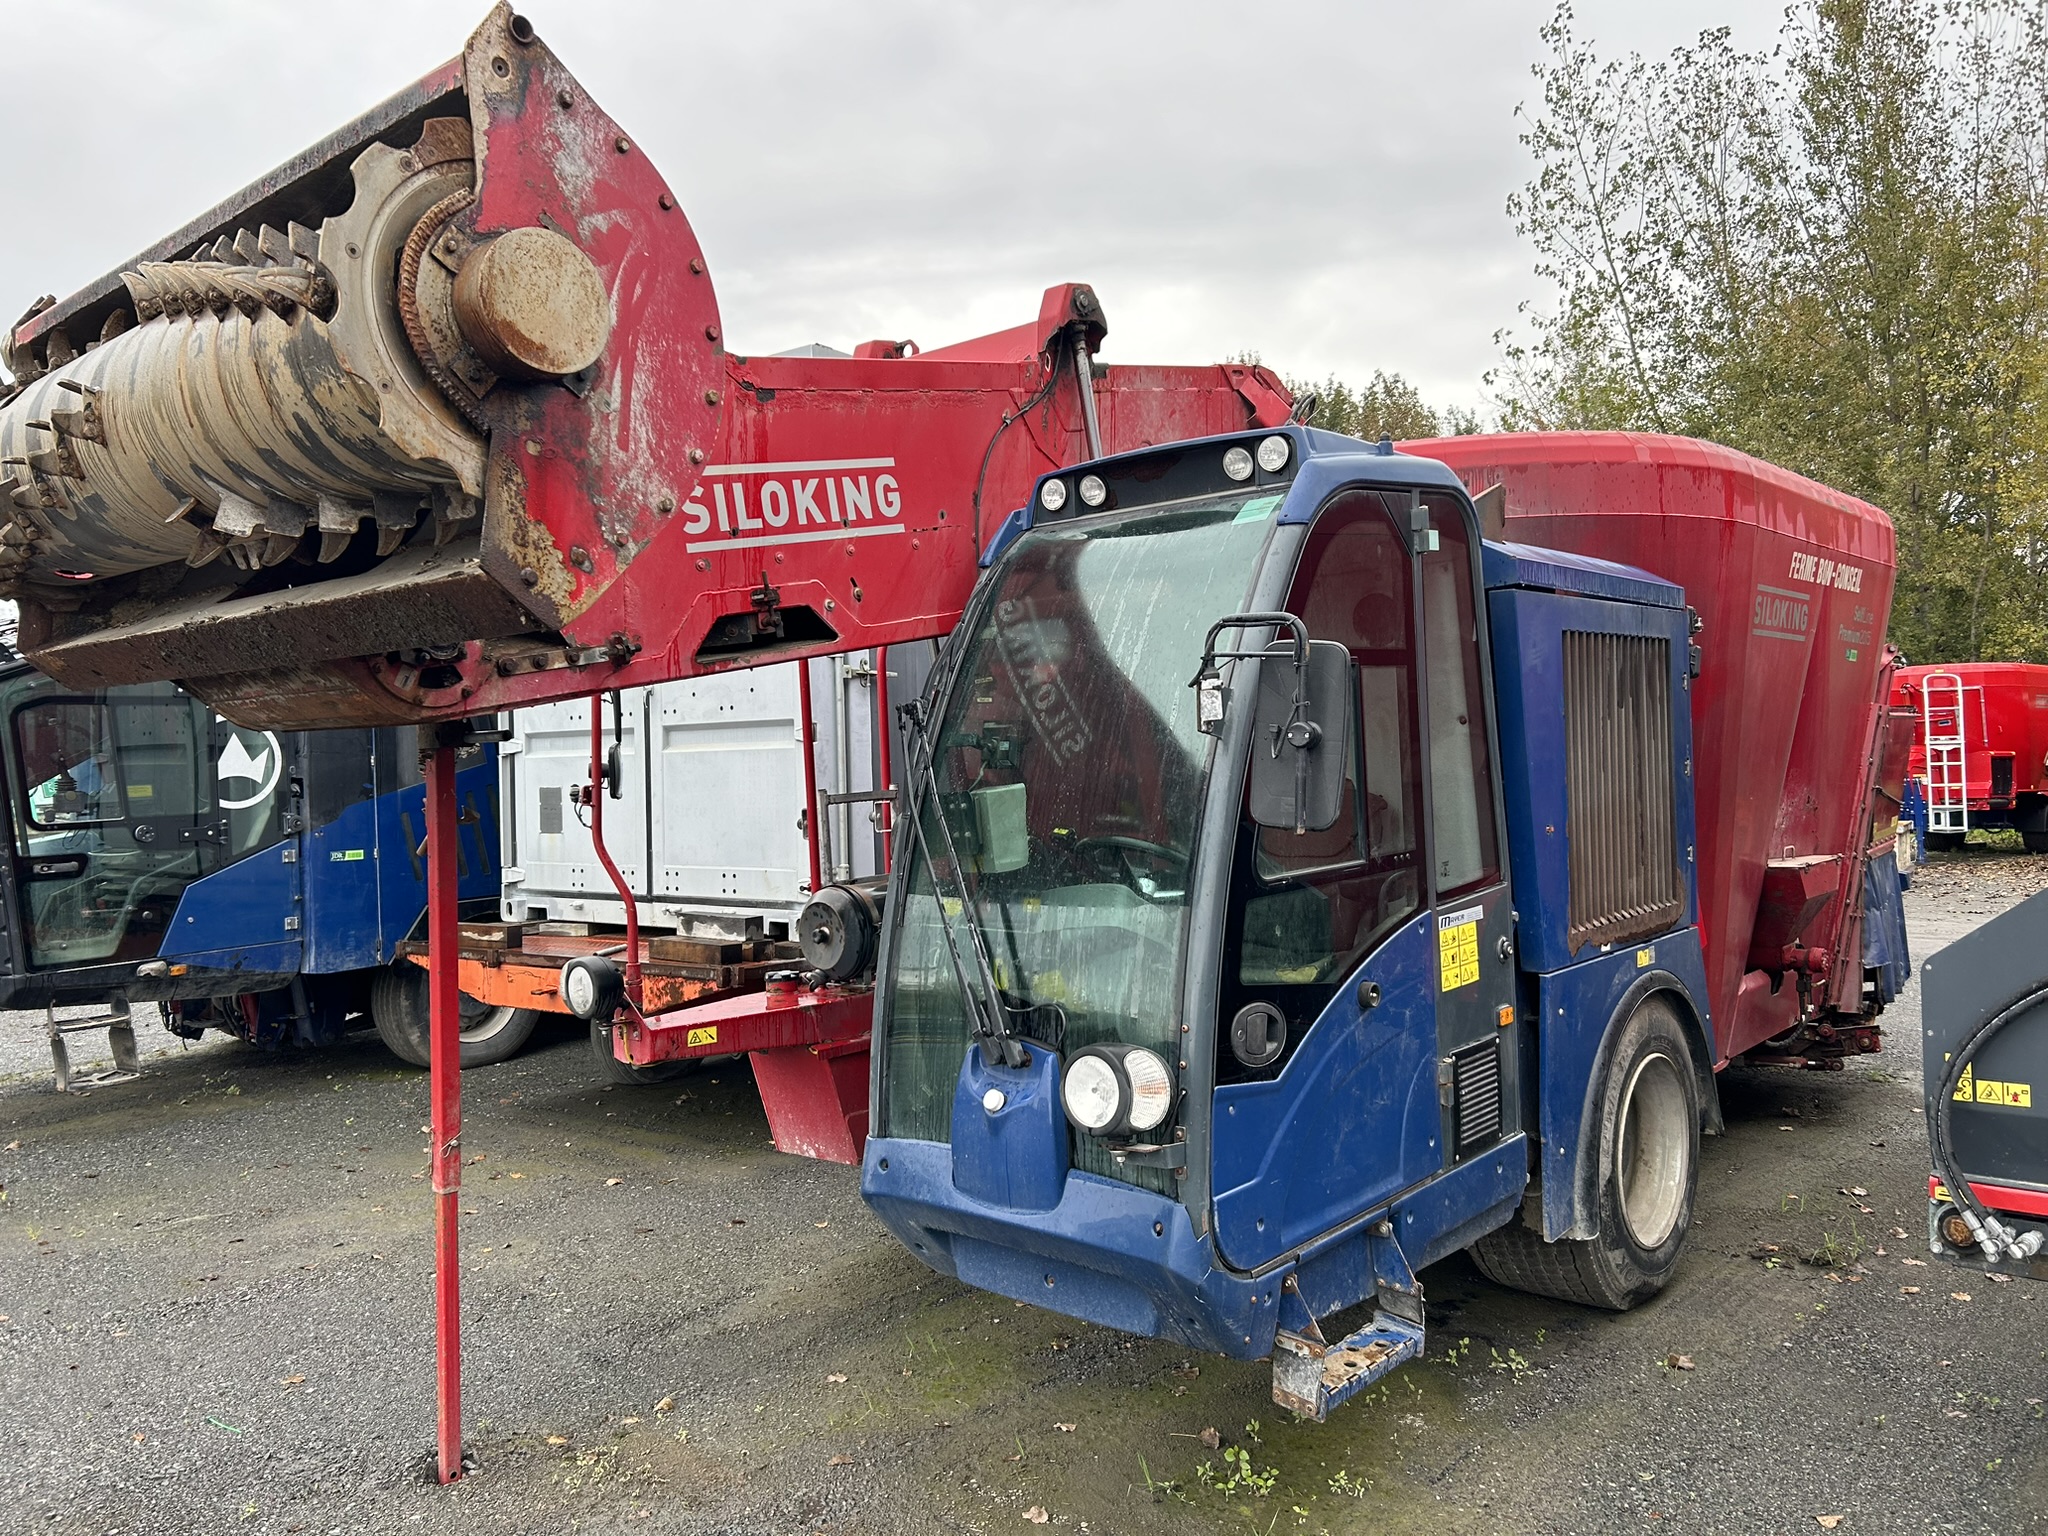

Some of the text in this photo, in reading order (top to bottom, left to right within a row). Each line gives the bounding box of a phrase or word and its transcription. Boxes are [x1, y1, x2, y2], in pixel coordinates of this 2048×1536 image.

[681, 473, 902, 535] SILOKING
[1789, 551, 1818, 582] FERME
[1754, 596, 1808, 631] SILOKING
